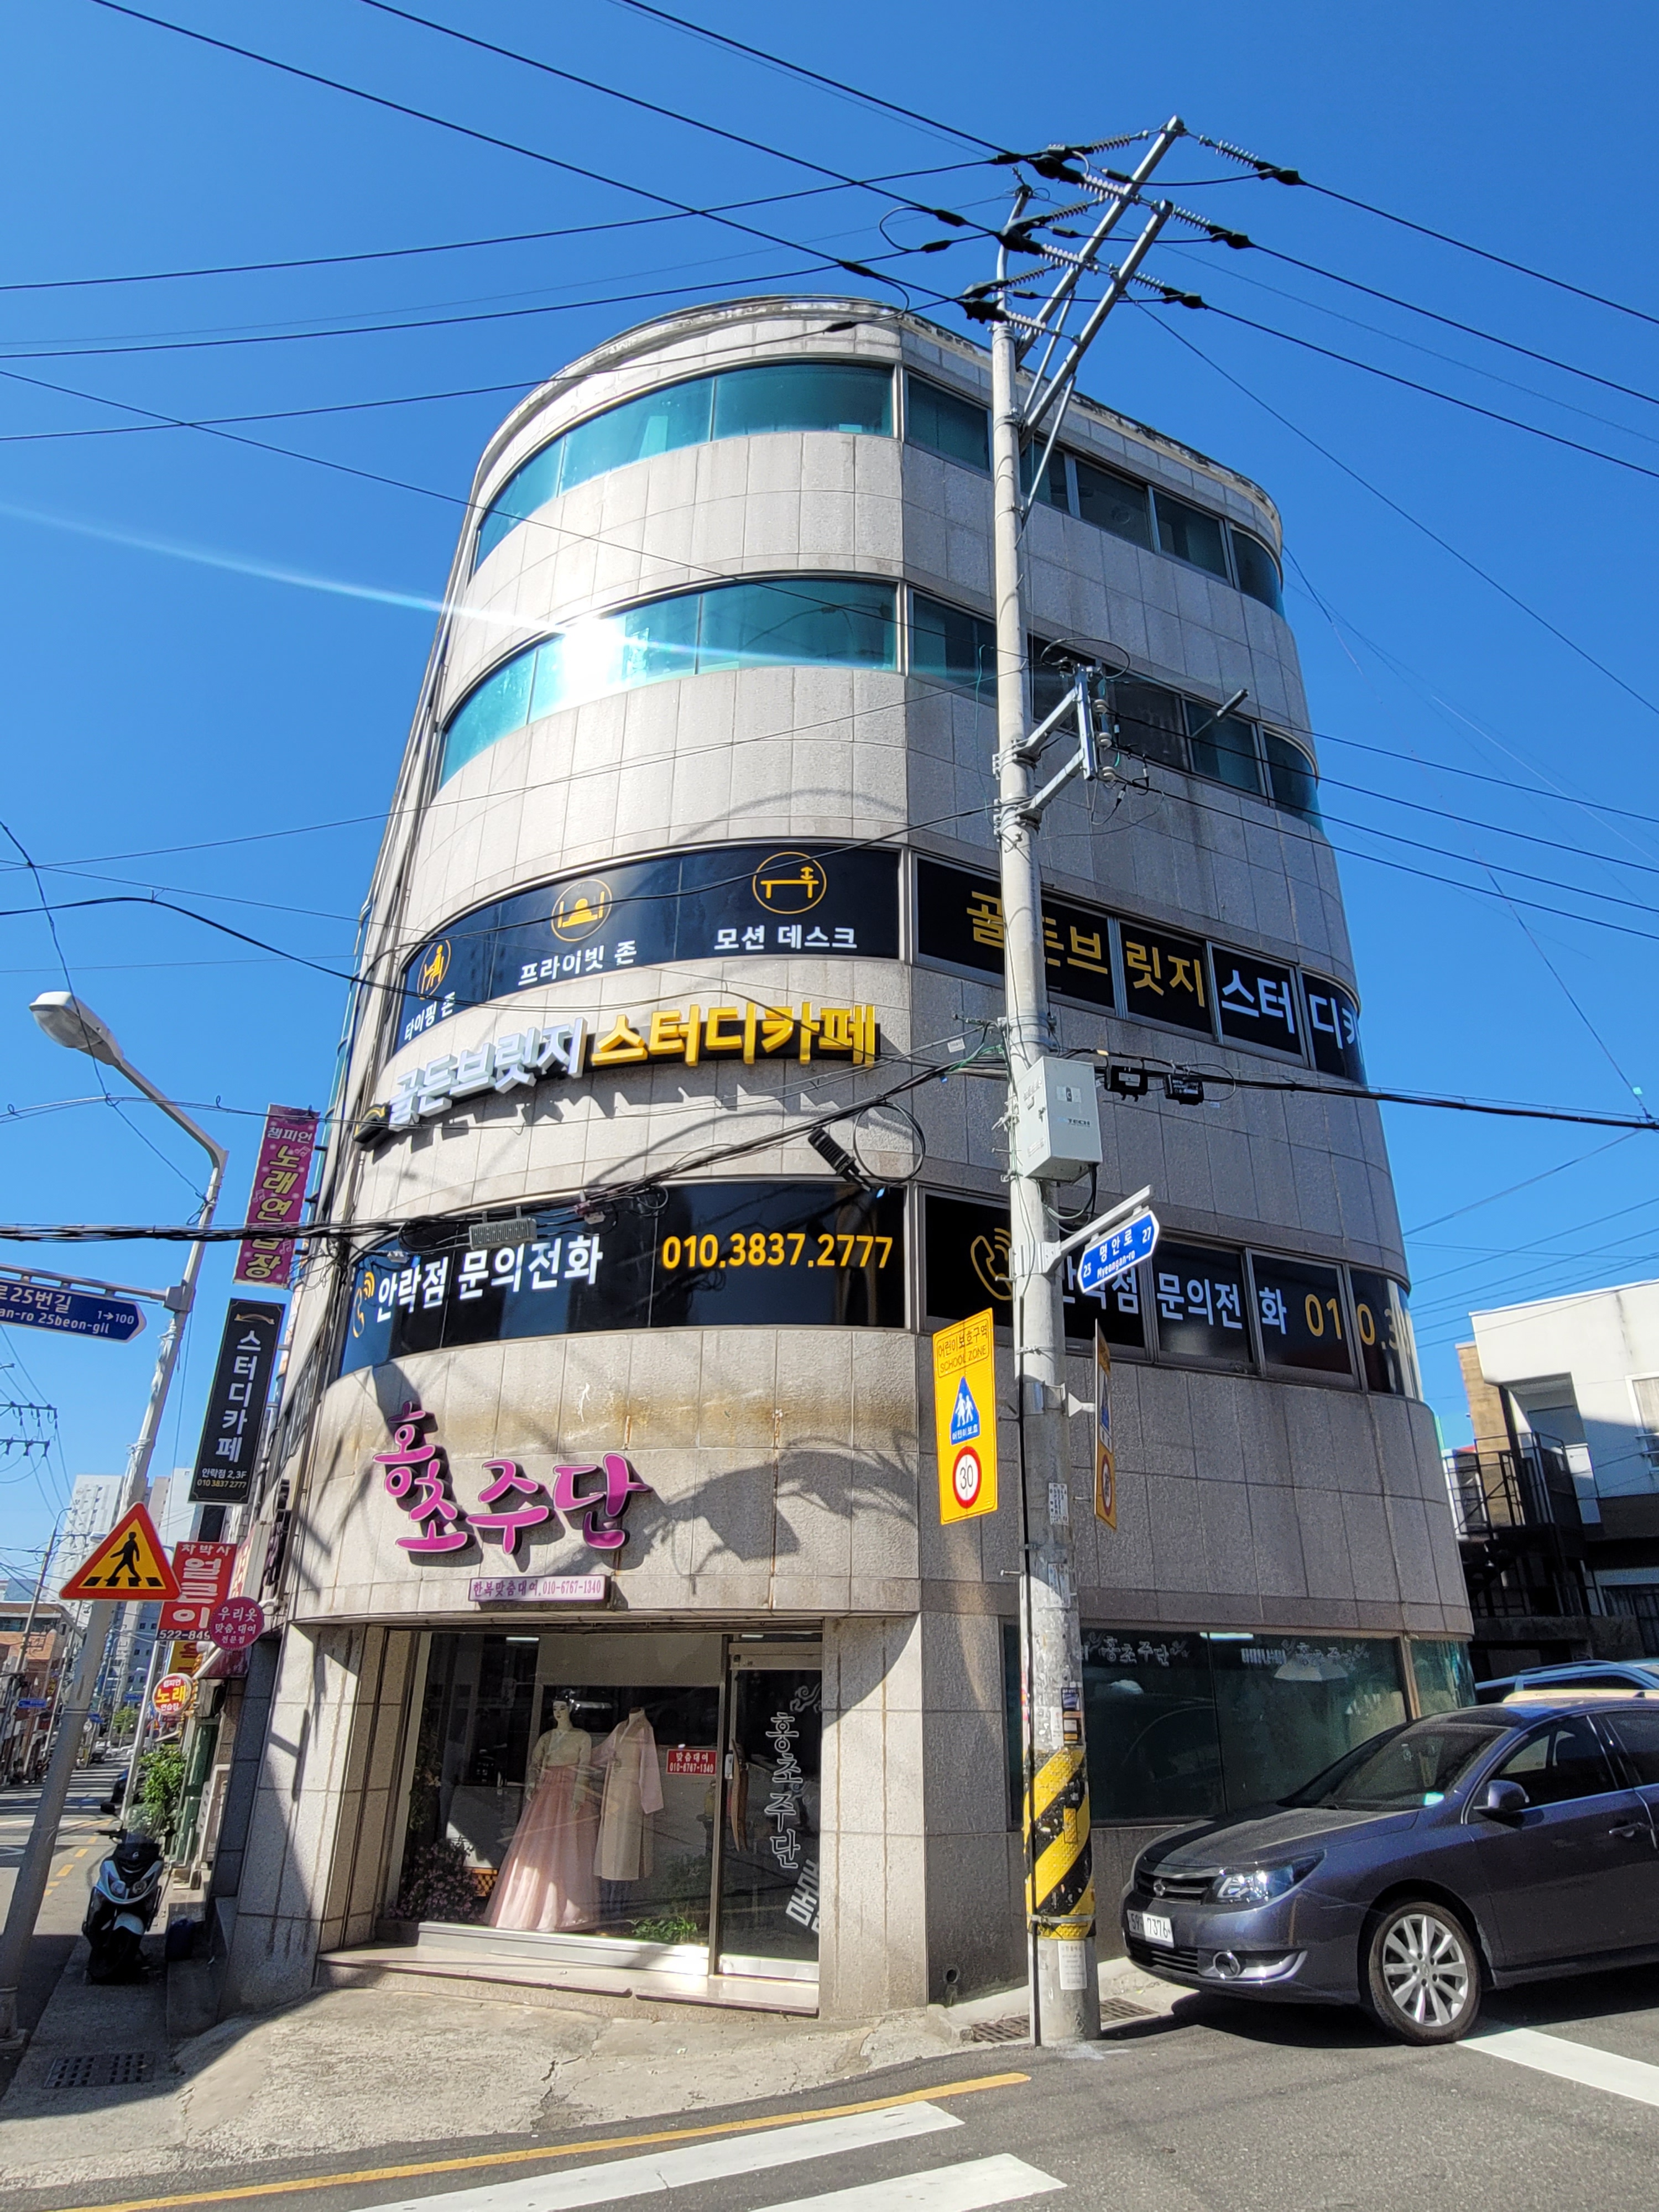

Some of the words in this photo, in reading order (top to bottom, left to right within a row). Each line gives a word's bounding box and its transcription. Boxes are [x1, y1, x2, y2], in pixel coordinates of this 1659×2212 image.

[714, 923, 765, 952] 모션
[777, 924, 857, 951] 데스크
[518, 944, 605, 987] 프라이빗
[614, 939, 637, 967] 존
[404, 1000, 437, 1041] 타이핑
[388, 1017, 588, 1132] 골든브릿지
[591, 1001, 875, 1067] 스터디카페
[267, 1126, 312, 1144] 챔피언
[1099, 1228, 1133, 1263] 명안로
[1142, 1226, 1152, 1244] 27
[663, 1231, 893, 1270] 010.3837.2777
[377, 1256, 448, 1323] 안락점
[458, 1235, 603, 1301] 문의전화
[1083, 1261, 1092, 1279] 23
[1157, 1272, 1288, 1335] 문의전화
[38, 1312, 109, 1334] 25beon-gil
[938, 1322, 988, 1358] 어린이보호구역
[940, 1354, 966, 1373] SCHOOL
[968, 1344, 987, 1362] ZONE
[215, 1329, 262, 1463] 스터디카페
[197, 1479, 210, 1487] 010
[211, 1479, 229, 1488] 3837
[229, 1480, 247, 1489] 2777
[201, 1467, 226, 1479] 안락점
[227, 1468, 248, 1480] 2,3F
[372, 1400, 656, 1555] 홍초주단
[959, 1460, 974, 1489] 30
[173, 1557, 222, 1629] 얼큰이
[218, 1606, 257, 1623] 우리옷
[159, 1629, 210, 1640] 522-849
[156, 1685, 186, 1703] 노래
[764, 1712, 803, 1869] 홍초주단
[1146, 1917, 1168, 1939] 7376
